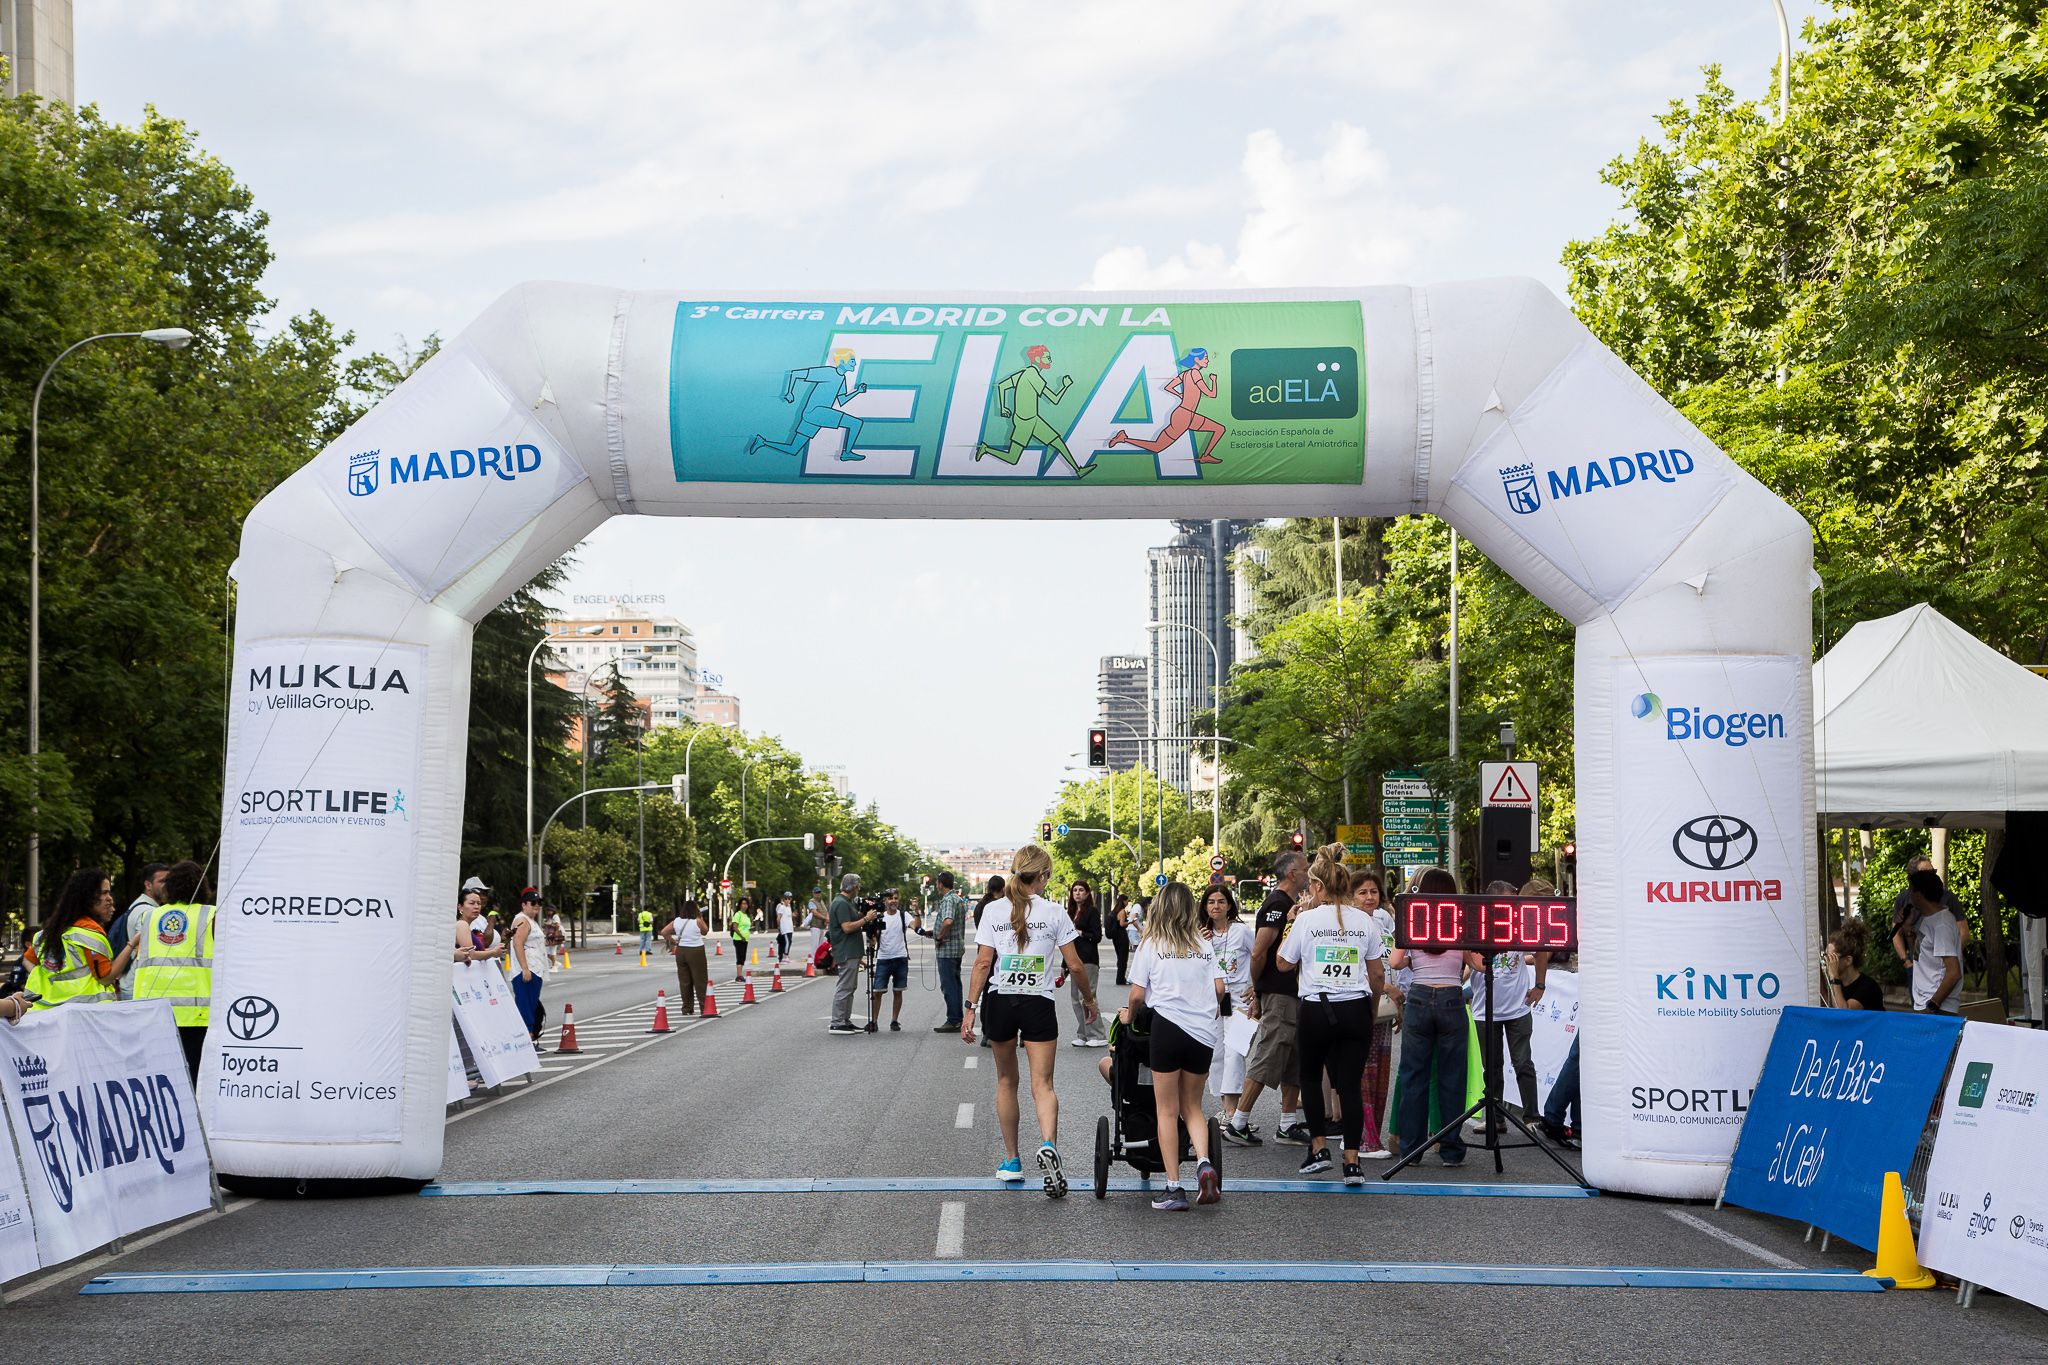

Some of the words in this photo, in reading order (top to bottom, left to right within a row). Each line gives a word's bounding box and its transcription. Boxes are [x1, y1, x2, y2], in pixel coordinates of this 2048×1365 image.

[689, 306, 719, 320] 3ª
[725, 306, 825, 321] Carrera
[835, 306, 1007, 327] MADRID
[1018, 307, 1109, 327] CON
[1119, 307, 1172, 327] LA
[1249, 379, 1340, 404] adELA
[801, 331, 1203, 480] ELA
[1230, 428, 1279, 437] Asociación
[1280, 427, 1320, 437] Española
[1322, 427, 1334, 435] de
[1230, 441, 1274, 449] Esclerosis
[1275, 440, 1306, 448] Lateral
[1307, 439, 1358, 448] Amiotrófica
[390, 444, 542, 485] MADRID
[1547, 448, 1694, 500] MADRID
[250, 664, 410, 694] MUKUA
[248, 698, 263, 715] by
[266, 694, 374, 714] VelillaGroup.
[240, 789, 388, 814] SPORTLIFE
[275, 815, 338, 825] COMUNICACIÓN
[347, 816, 386, 827] EVENTOS
[1408, 902, 1569, 944] 00:13:05
[1007, 972, 1037, 987] 495
[1322, 964, 1352, 978] 494
[1656, 967, 1780, 1000] KINTO
[1657, 1007, 1696, 1017] Flexible
[1698, 1007, 1739, 1018] Mobility
[1740, 1006, 1781, 1017] Solutions
[221, 1053, 279, 1076] Toyota
[1790, 1039, 1822, 1098] De
[1817, 1039, 1841, 1099] la
[219, 1079, 301, 1100] Financial
[310, 1081, 397, 1100] Services
[58, 1073, 186, 1175] MADRID
[1632, 1113, 1678, 1125] MOVILIDAD,
[1768, 1122, 1792, 1182] al
